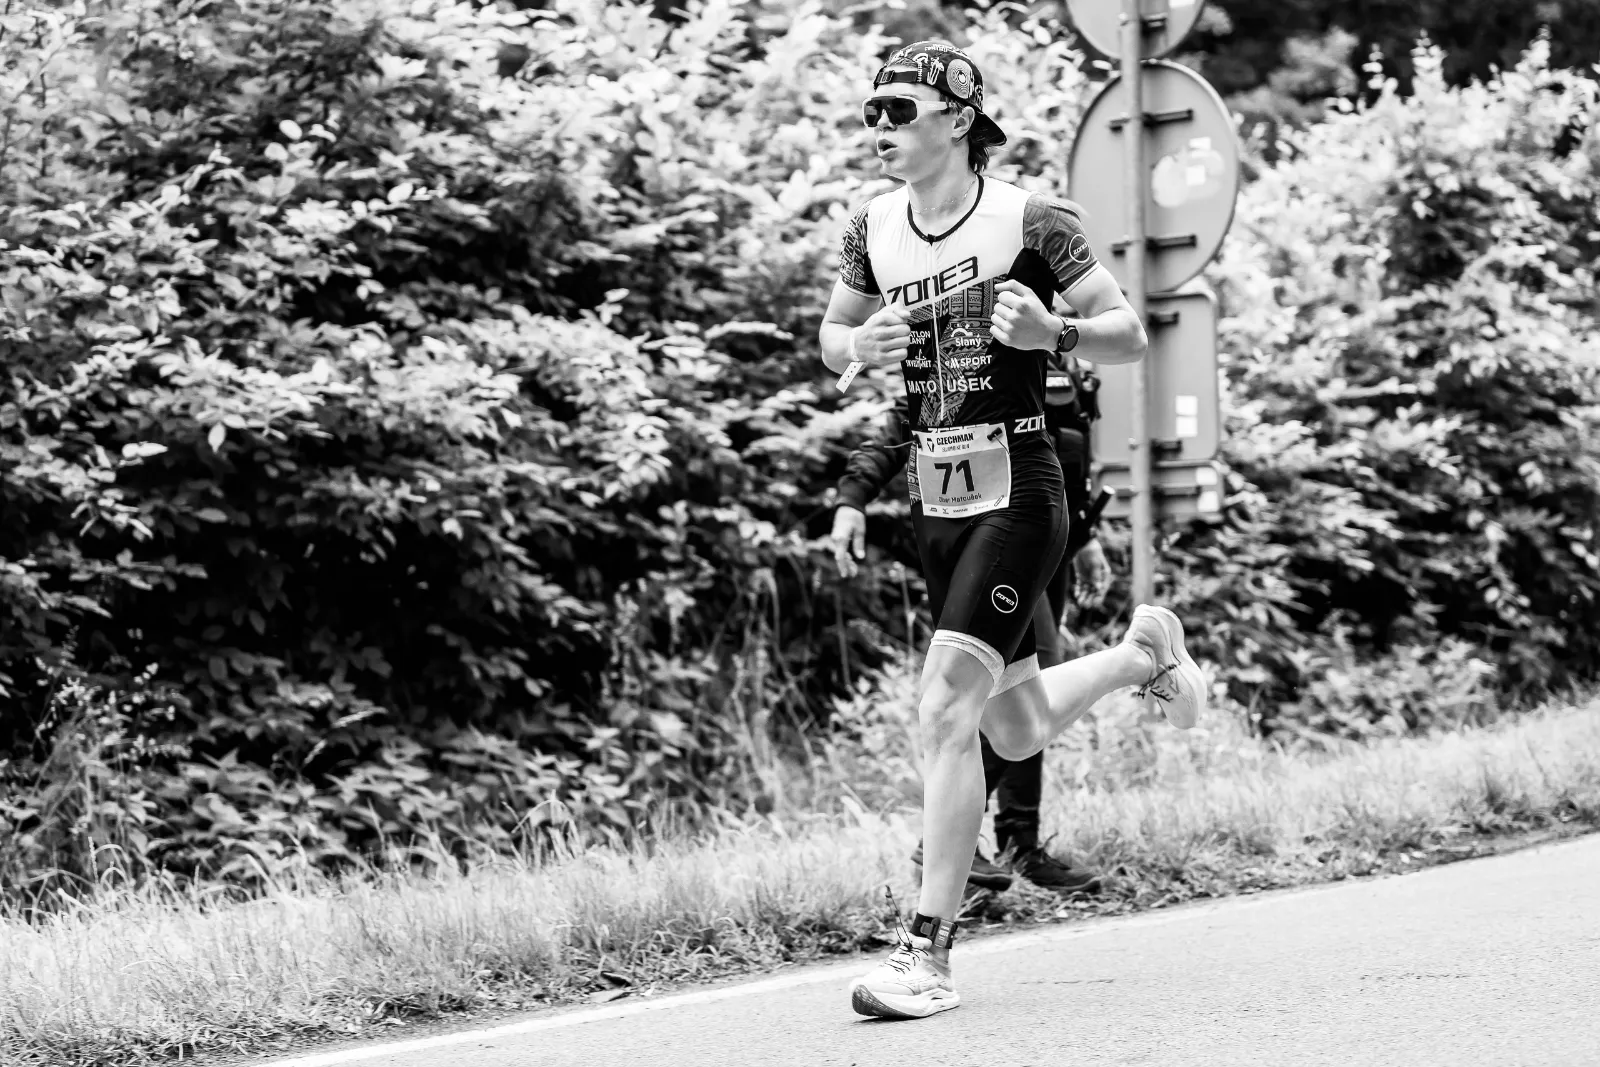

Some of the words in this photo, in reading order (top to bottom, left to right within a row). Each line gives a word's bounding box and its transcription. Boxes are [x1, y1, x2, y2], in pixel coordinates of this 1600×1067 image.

[886, 256, 979, 307] ZONE3
[955, 334, 982, 347] Slaný
[936, 433, 974, 446] CZECHMAN
[934, 459, 975, 495] 71
